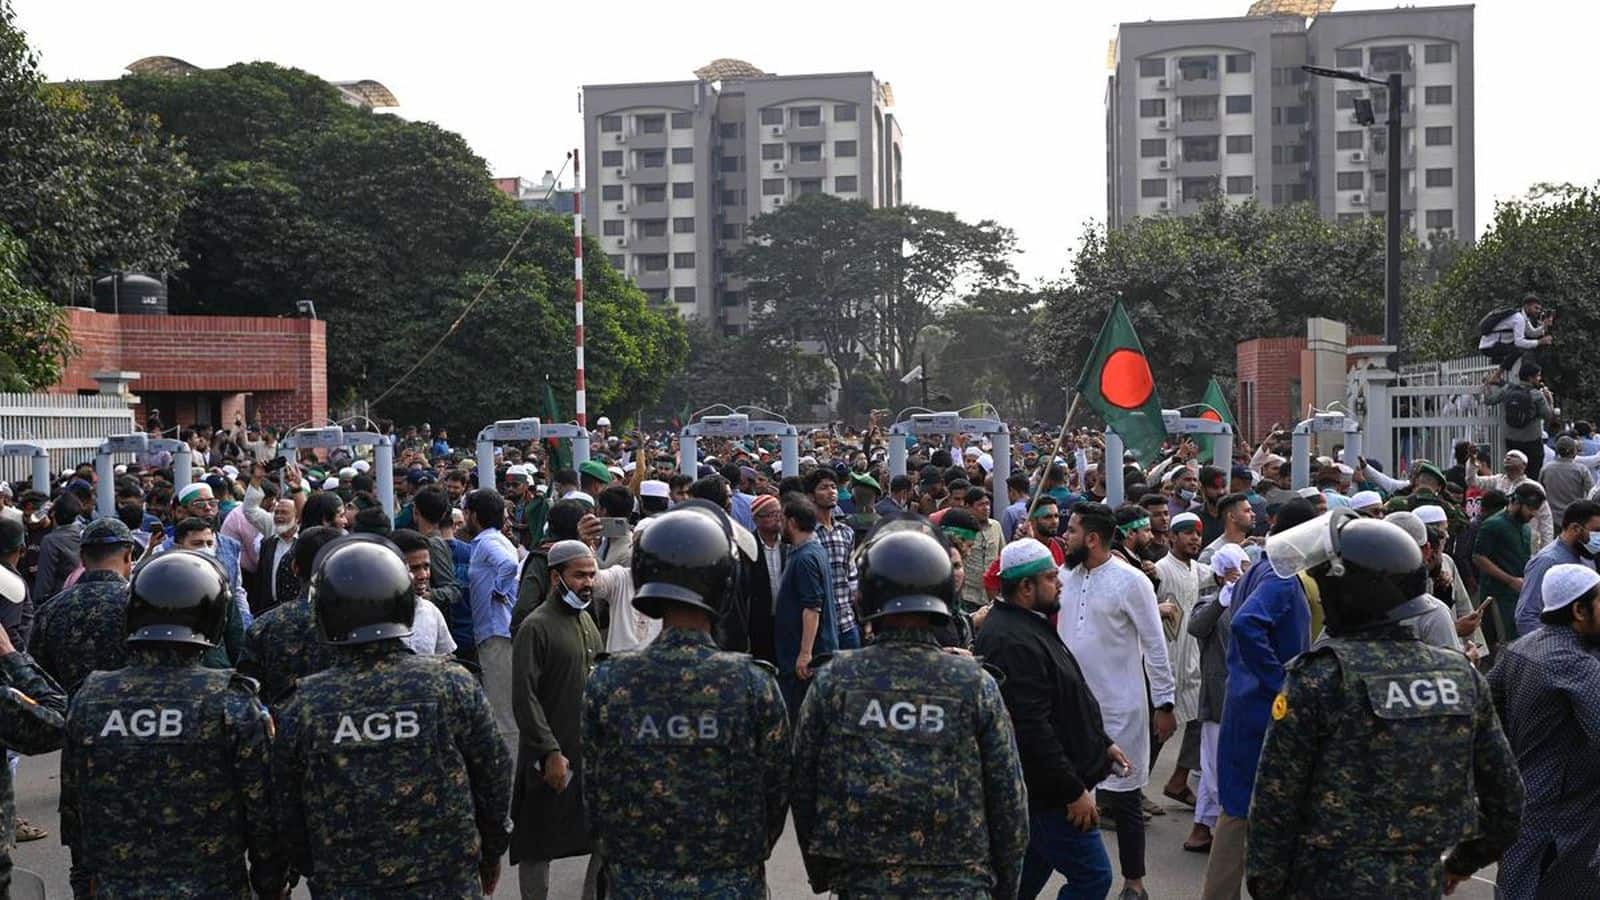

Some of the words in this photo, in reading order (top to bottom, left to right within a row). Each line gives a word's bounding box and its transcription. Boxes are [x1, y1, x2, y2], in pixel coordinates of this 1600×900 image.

[1385, 678, 1460, 709] AGB
[100, 709, 183, 737] AGB
[332, 710, 421, 744] AGB
[637, 714, 720, 739] AGB
[859, 699, 945, 733] AGB
